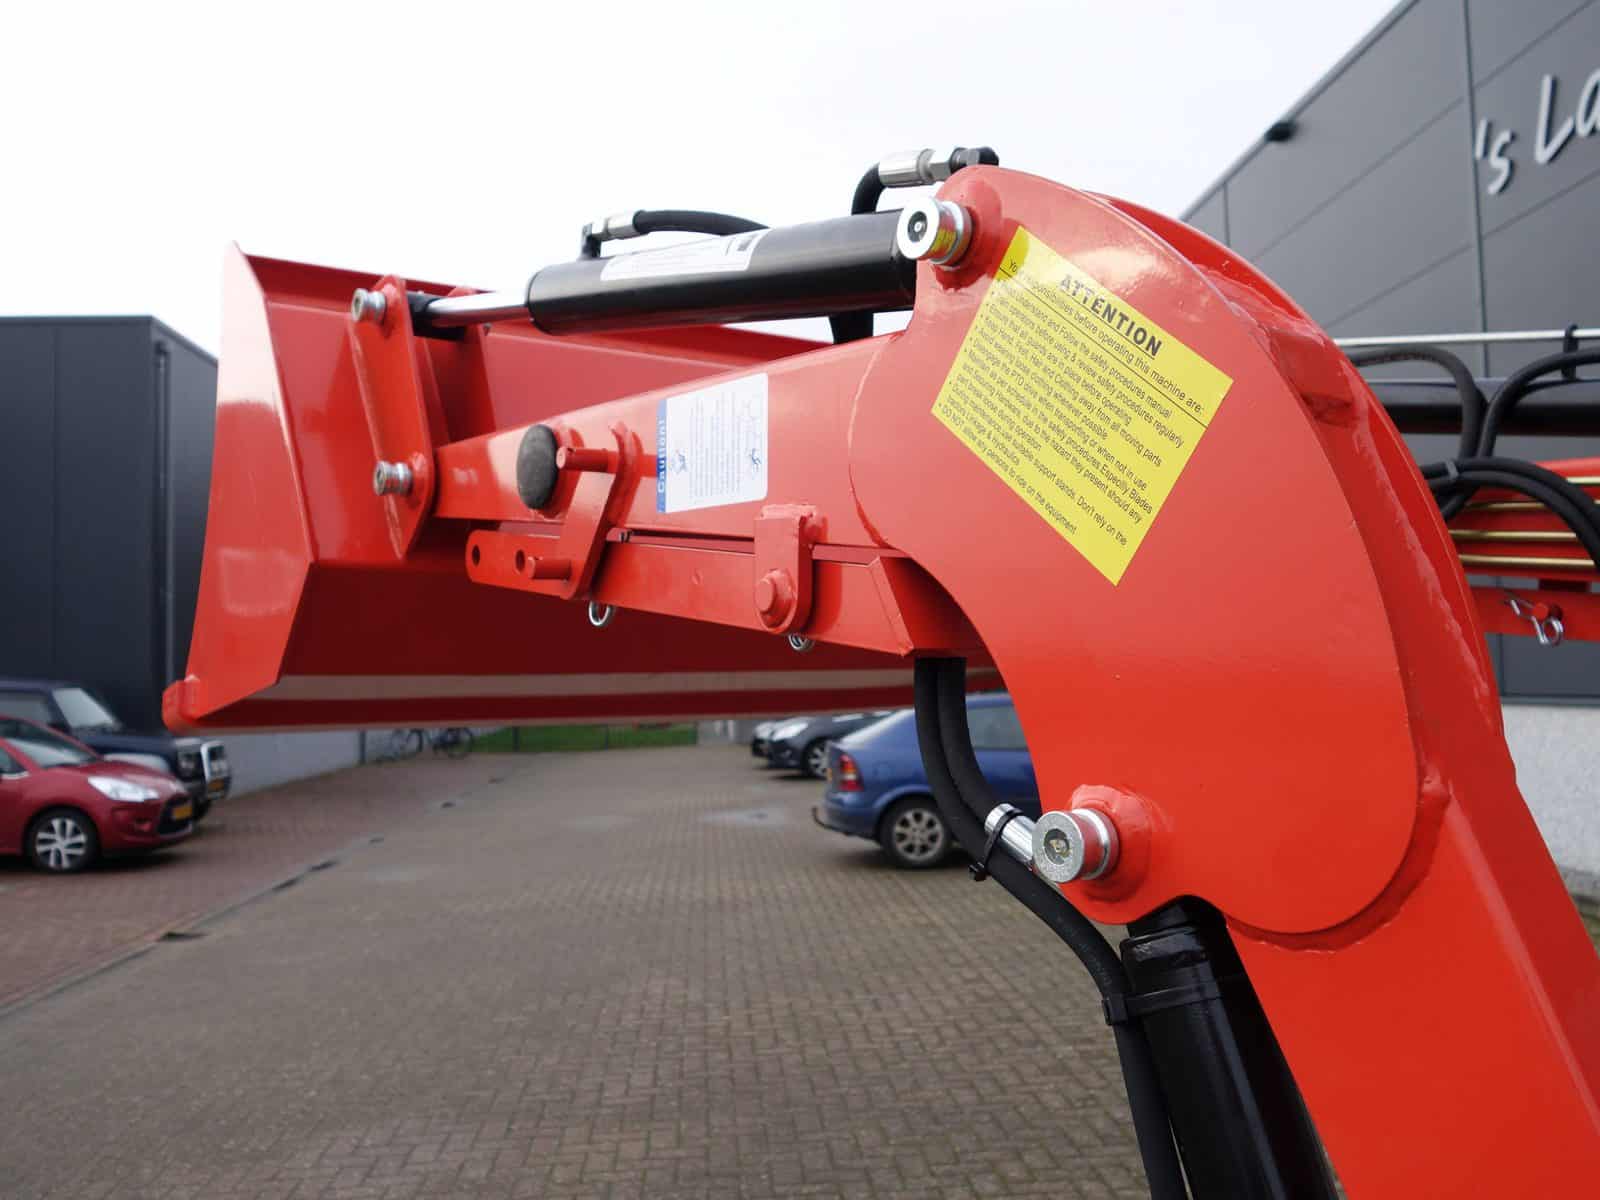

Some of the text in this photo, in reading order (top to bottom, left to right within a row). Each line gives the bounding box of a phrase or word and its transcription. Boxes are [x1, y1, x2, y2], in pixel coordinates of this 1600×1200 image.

[1475, 116, 1511, 194] 's
[1059, 271, 1163, 357] ATTENTION
[1073, 309, 1099, 334] before
[1096, 328, 1135, 365] operating
[1133, 356, 1151, 374] this
[1149, 368, 1186, 401] machine
[1095, 373, 1117, 396] safety
[1114, 389, 1154, 426] procedures
[1107, 365, 1146, 402] procedures
[1144, 394, 1172, 420] manual
[1009, 369, 1024, 386] PTO
[1096, 444, 1115, 464] when
[1113, 459, 1127, 474] not
[1132, 476, 1147, 492] use
[1094, 408, 1112, 426] from
[1142, 447, 1162, 469] parts
[1076, 496, 1095, 517] Don't
[1105, 524, 1116, 536] on
[1082, 467, 1108, 495] present
[1126, 508, 1142, 525] any
[1127, 488, 1153, 514] Blades
